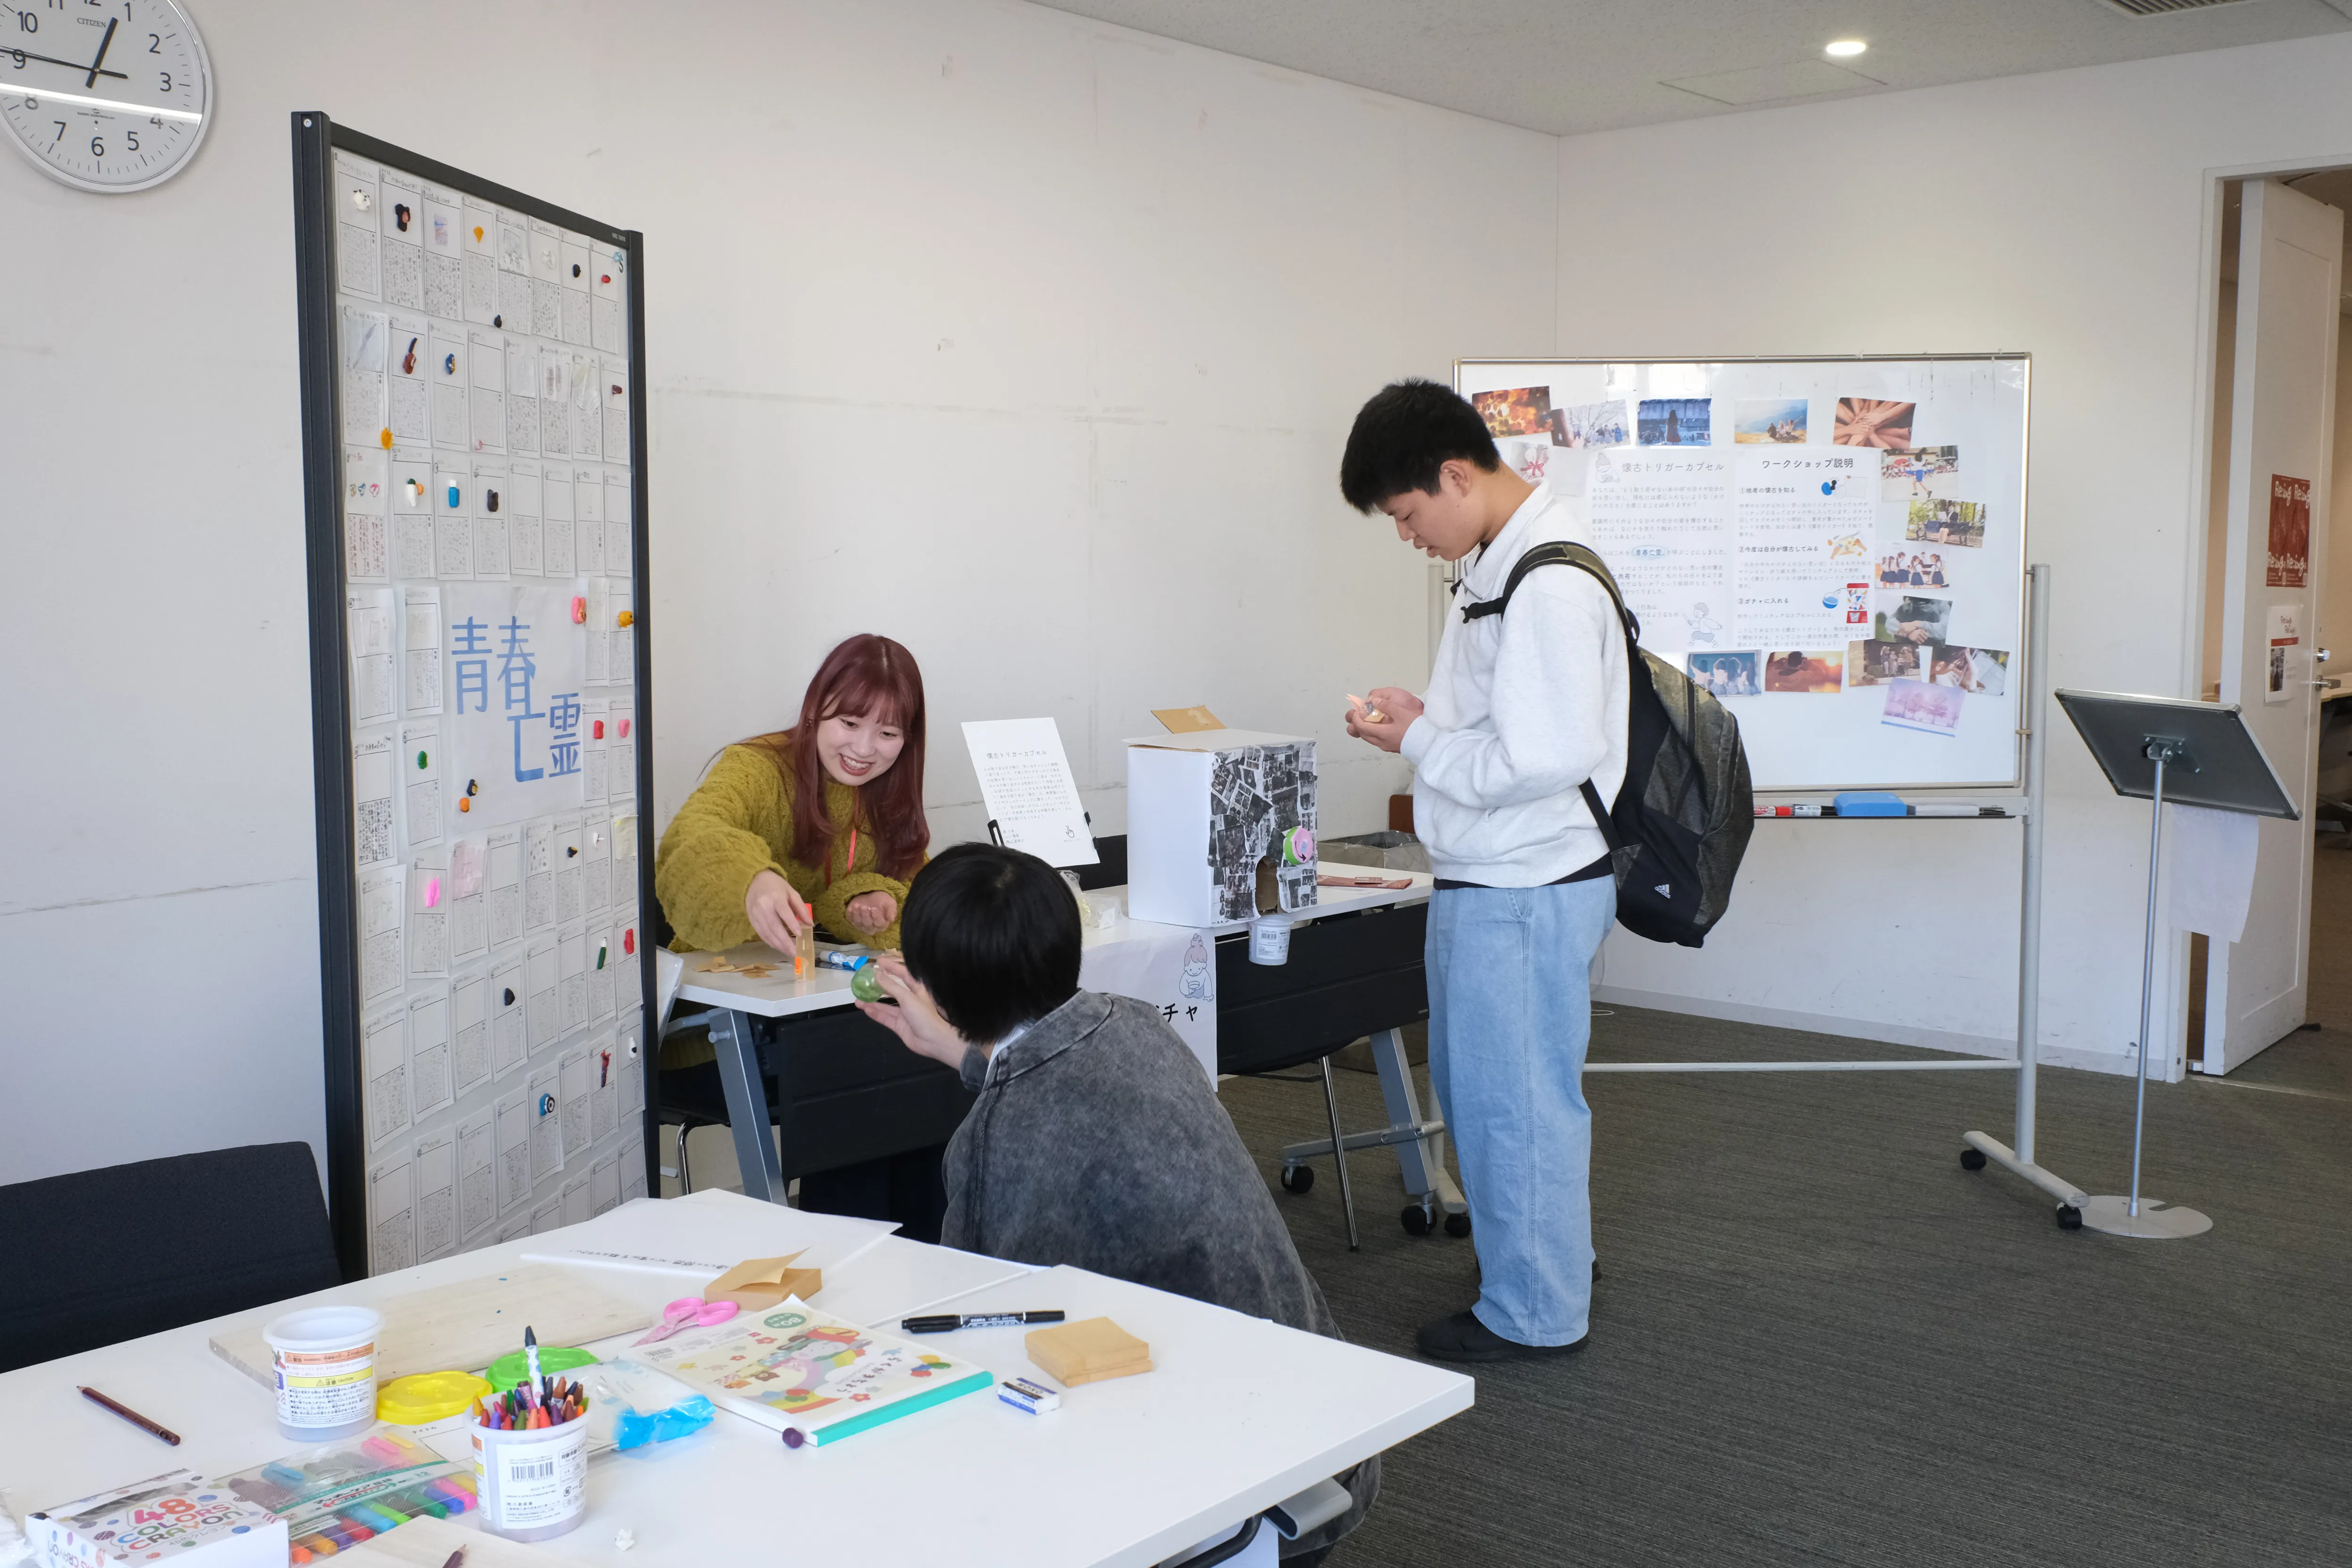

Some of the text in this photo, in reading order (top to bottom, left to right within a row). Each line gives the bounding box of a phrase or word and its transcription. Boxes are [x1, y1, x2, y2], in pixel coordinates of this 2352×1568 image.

[17, 11, 38, 33] 10
[124, 2, 131, 22] 1
[77, 17, 106, 28] CITIZEN
[149, 34, 161, 54] 2
[12, 49, 26, 69] 9
[160, 72, 172, 92] 3
[54, 121, 66, 141] 7
[127, 131, 139, 151] 5
[91, 136, 104, 157] 6
[1622, 462, 1724, 472] 懐古トリガーカプセル
[1762, 458, 1854, 469] ワークショップ説明
[451, 615, 536, 715] 青春
[986, 749, 1047, 759] 懐古トリガーカプセル
[1156, 1003, 1198, 1023] チャ
[134, 1498, 197, 1525] 48
[118, 1504, 230, 1544] COLORS
